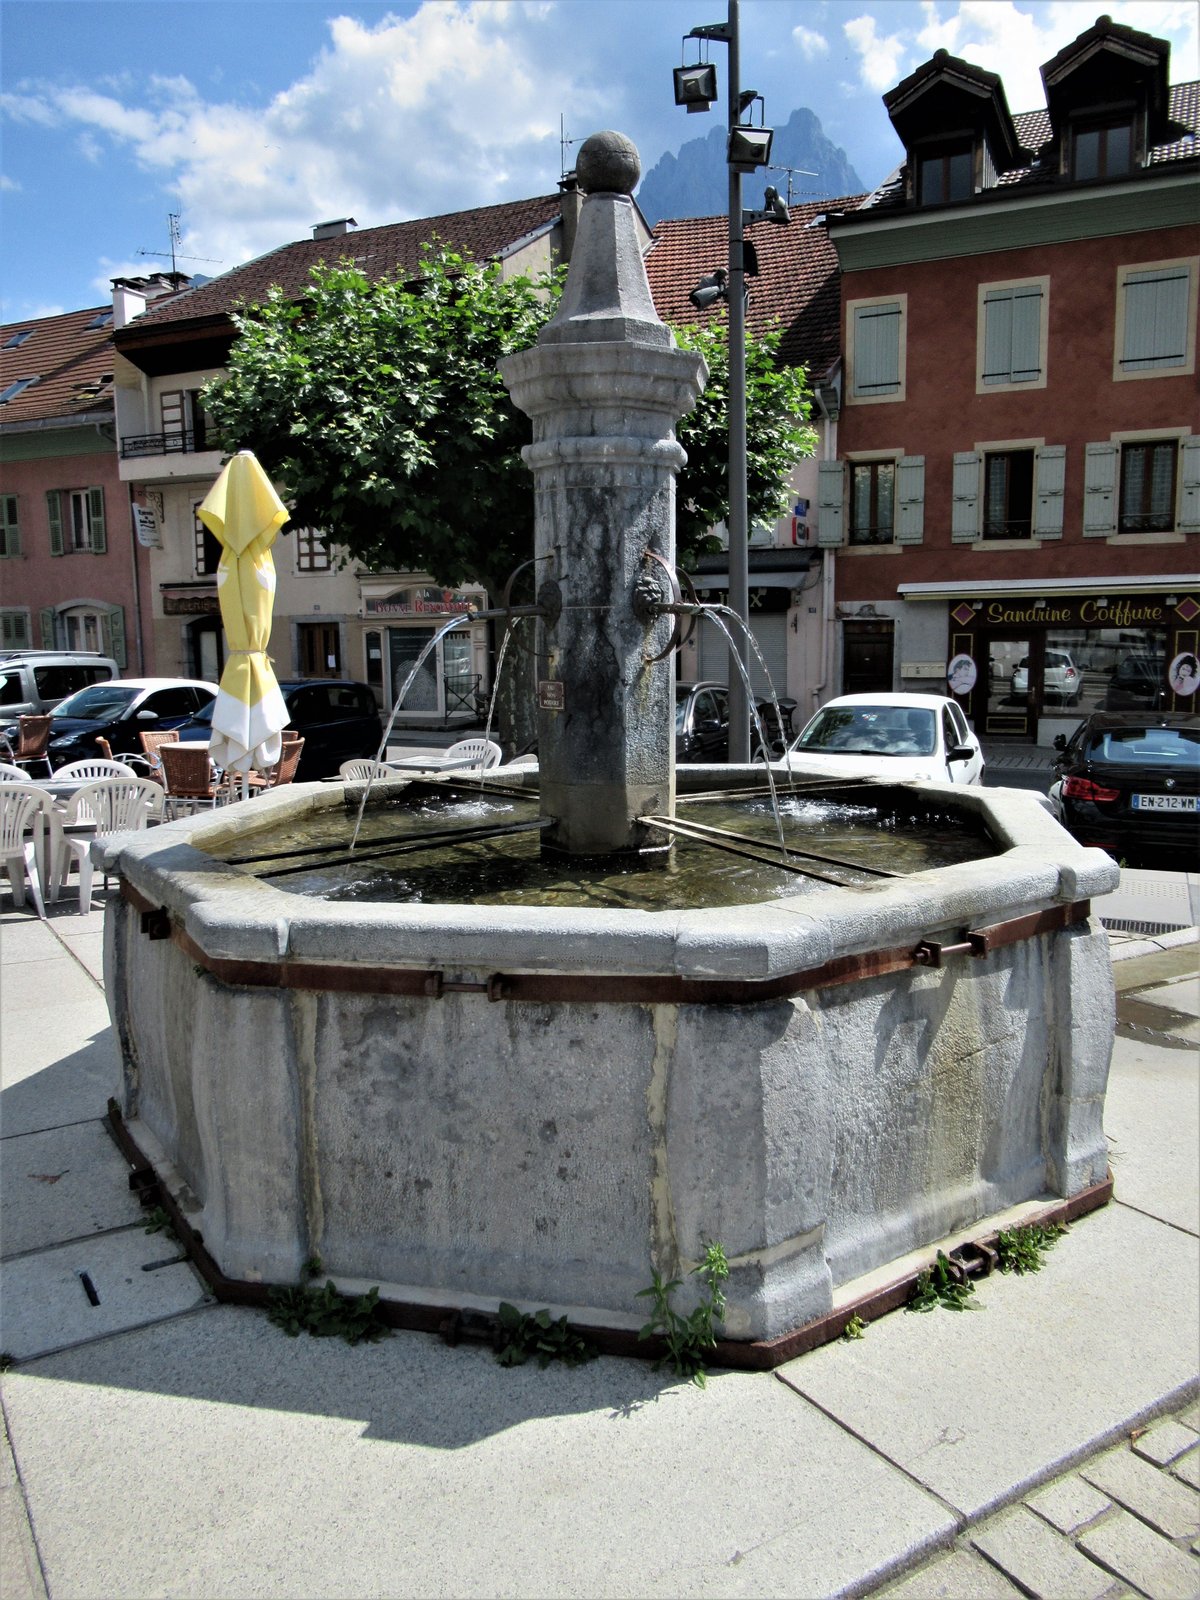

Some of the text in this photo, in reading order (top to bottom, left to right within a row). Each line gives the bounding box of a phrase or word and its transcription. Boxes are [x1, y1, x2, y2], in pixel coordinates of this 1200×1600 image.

[987, 600, 1162, 626] Sandrine Coiffure
[1141, 796, 1195, 809] EN-212-WM
